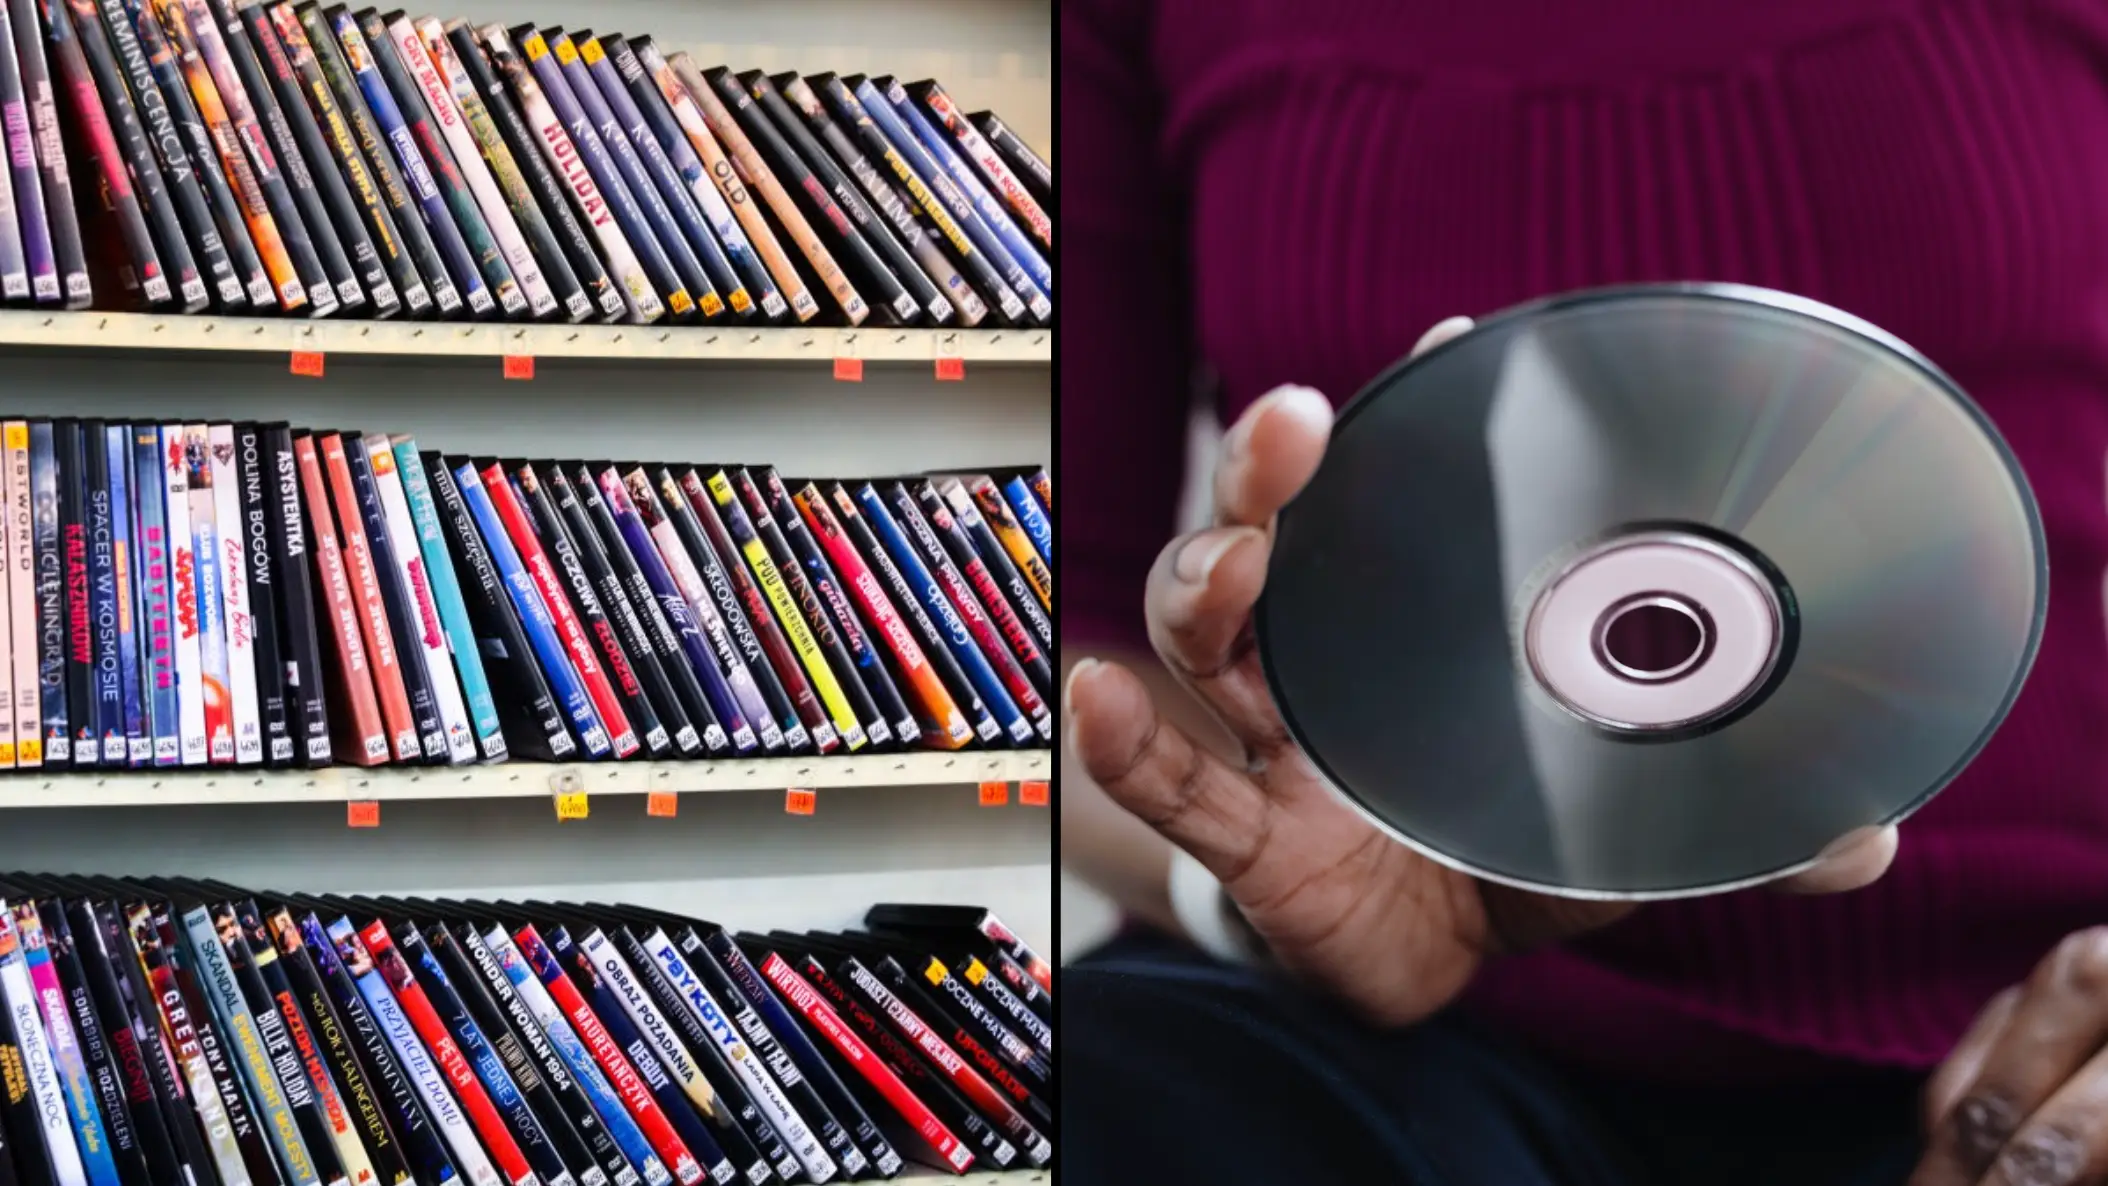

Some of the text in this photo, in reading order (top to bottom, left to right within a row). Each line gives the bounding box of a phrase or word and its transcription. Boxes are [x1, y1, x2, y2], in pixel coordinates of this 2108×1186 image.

[402, 34, 427, 67] CRY
[420, 69, 456, 126] MACHO
[543, 121, 611, 227] HOLIDAY
[712, 158, 748, 205] OLD
[982, 153, 1004, 178] JAK
[15, 449, 30, 570] ESTWORLD
[241, 433, 273, 583] DOLINA BOGÓW
[277, 450, 303, 555] ASYSTENTKA
[353, 456, 383, 541] TENET
[433, 469, 460, 510] małe
[92, 489, 118, 701] SPACER W KOSMOSIE
[148, 526, 171, 688] BABYTEETH
[323, 534, 346, 601] WAKACJE
[351, 531, 375, 598] WAKACJE
[530, 553, 569, 617] pojedynek
[563, 618, 578, 638] na
[554, 538, 600, 617] UCZCIWY
[703, 562, 760, 662] SKŁODOWSKA
[754, 557, 780, 587] POD
[782, 558, 838, 647] PINOKIO
[940, 562, 983, 623] PRAWDY
[963, 559, 1038, 663] BANKSTERZY
[1007, 576, 1026, 597] PO
[1024, 556, 1051, 601] NIE
[42, 572, 61, 684] LENINGRAD
[915, 612, 940, 643] SERCE
[276, 990, 315, 1057] POZIOM
[463, 932, 571, 1091] WONDER WOMAN 1984
[604, 958, 695, 1082] OBRAZ POŻĄDANIA
[763, 959, 815, 1012] WIRTUOZ
[849, 967, 886, 1002] JUDASZ
[886, 1001, 923, 1038] CZARNY
[917, 1032, 962, 1075] MESJASZ
[940, 974, 984, 1017] ROCZNE
[980, 1012, 1030, 1061] MATERIE
[16, 1003, 63, 1128] SŁONECZNA NOC
[70, 987, 104, 1061] SONGBIRD
[95, 1066, 132, 1149] ROZDZIELENI
[161, 988, 228, 1140] GREENLAND
[197, 1024, 252, 1137] TONY HALIK
[256, 1009, 312, 1109] BILLIE HOLIDAY
[321, 1017, 342, 1047] ROK
[340, 1059, 389, 1147] SALINGEREM
[343, 996, 424, 1130] NIEZAPOMNIANA
[376, 996, 460, 1127] PRZYJACIEL DOMU
[433, 1036, 472, 1086] PĘTLA
[450, 1010, 541, 1147] 7 LAT JEDNEJ NOCY
[573, 1006, 651, 1112] MAURETAŃCZYK
[734, 1006, 770, 1046] TAJNI
[765, 1048, 801, 1088] FAJNI
[953, 1029, 1029, 1101] UPGRADE
[272, 1110, 312, 1179] MOLESTY
